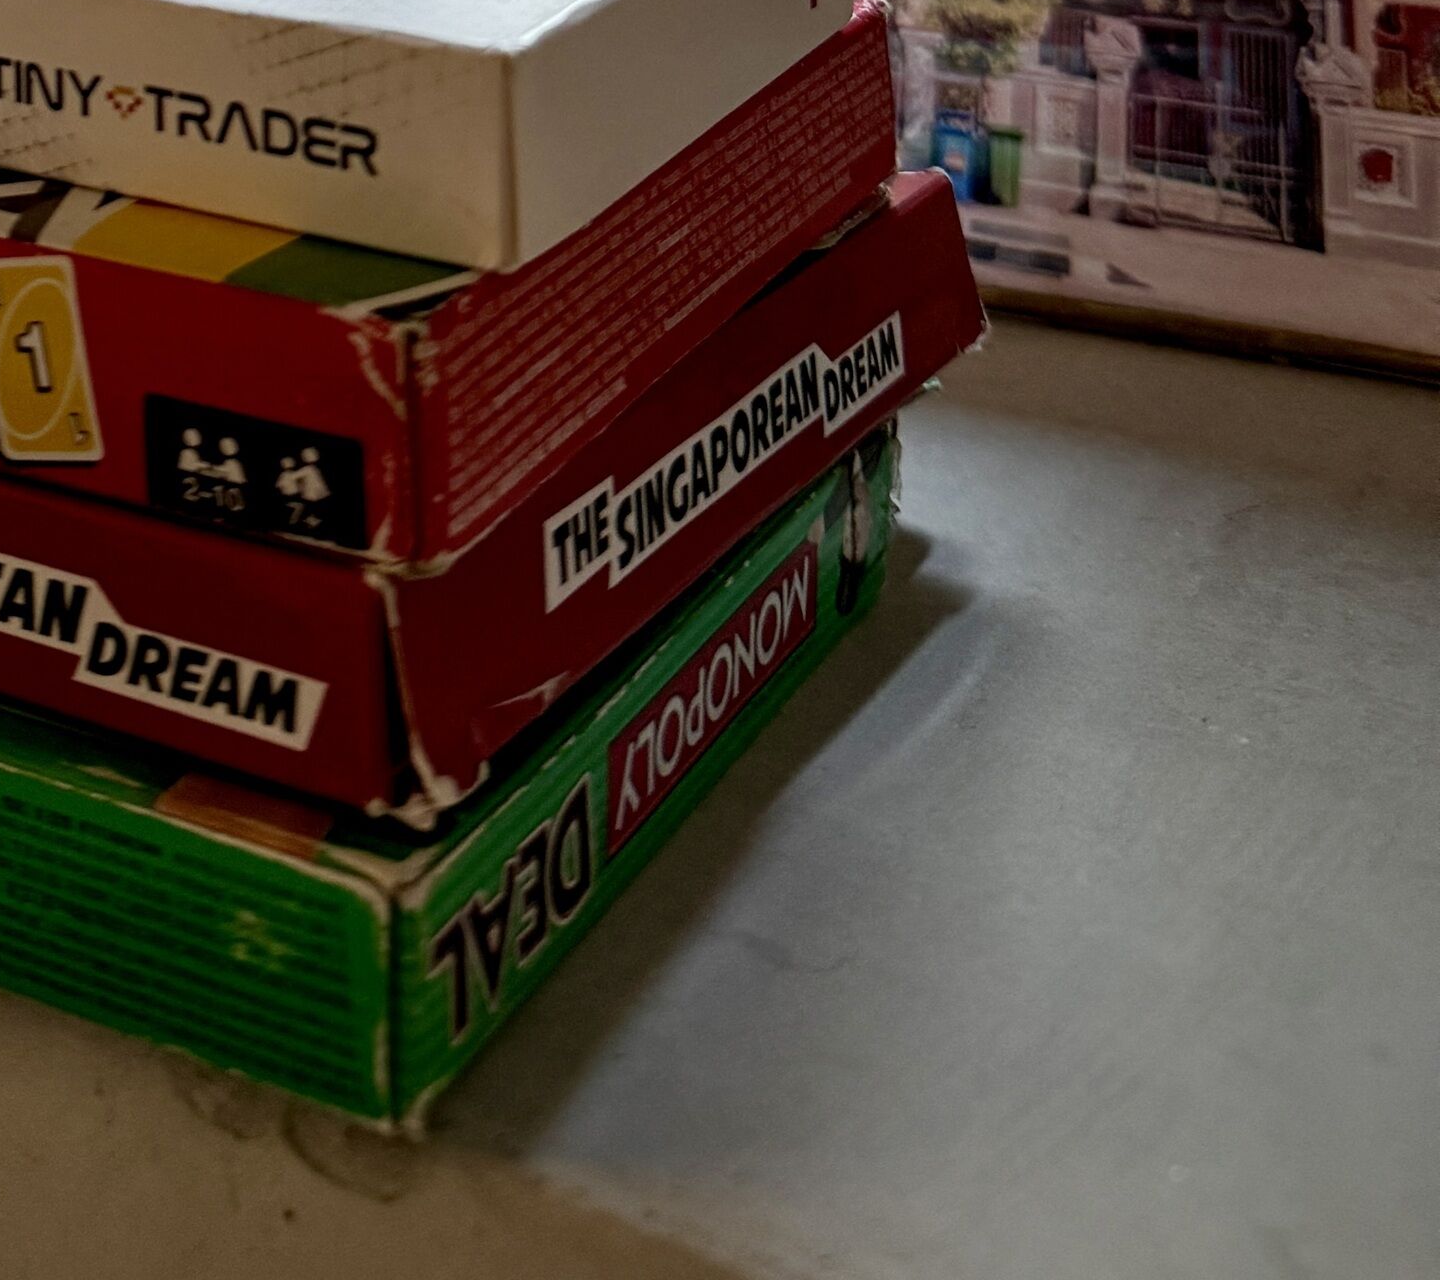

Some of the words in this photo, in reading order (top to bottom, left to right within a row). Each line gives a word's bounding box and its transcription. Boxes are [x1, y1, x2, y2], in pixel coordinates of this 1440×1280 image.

[143, 84, 379, 177] TRADER
[16, 320, 52, 394] 1
[180, 476, 248, 513] 2-10
[284, 500, 324, 529] 7+
[550, 487, 613, 587] THE
[611, 350, 821, 572] SINGAPOREAN
[820, 323, 903, 423] DREAM
[86, 622, 301, 736] DREAM
[613, 554, 811, 832] MONOPOLY
[426, 772, 594, 1047] DEAL
